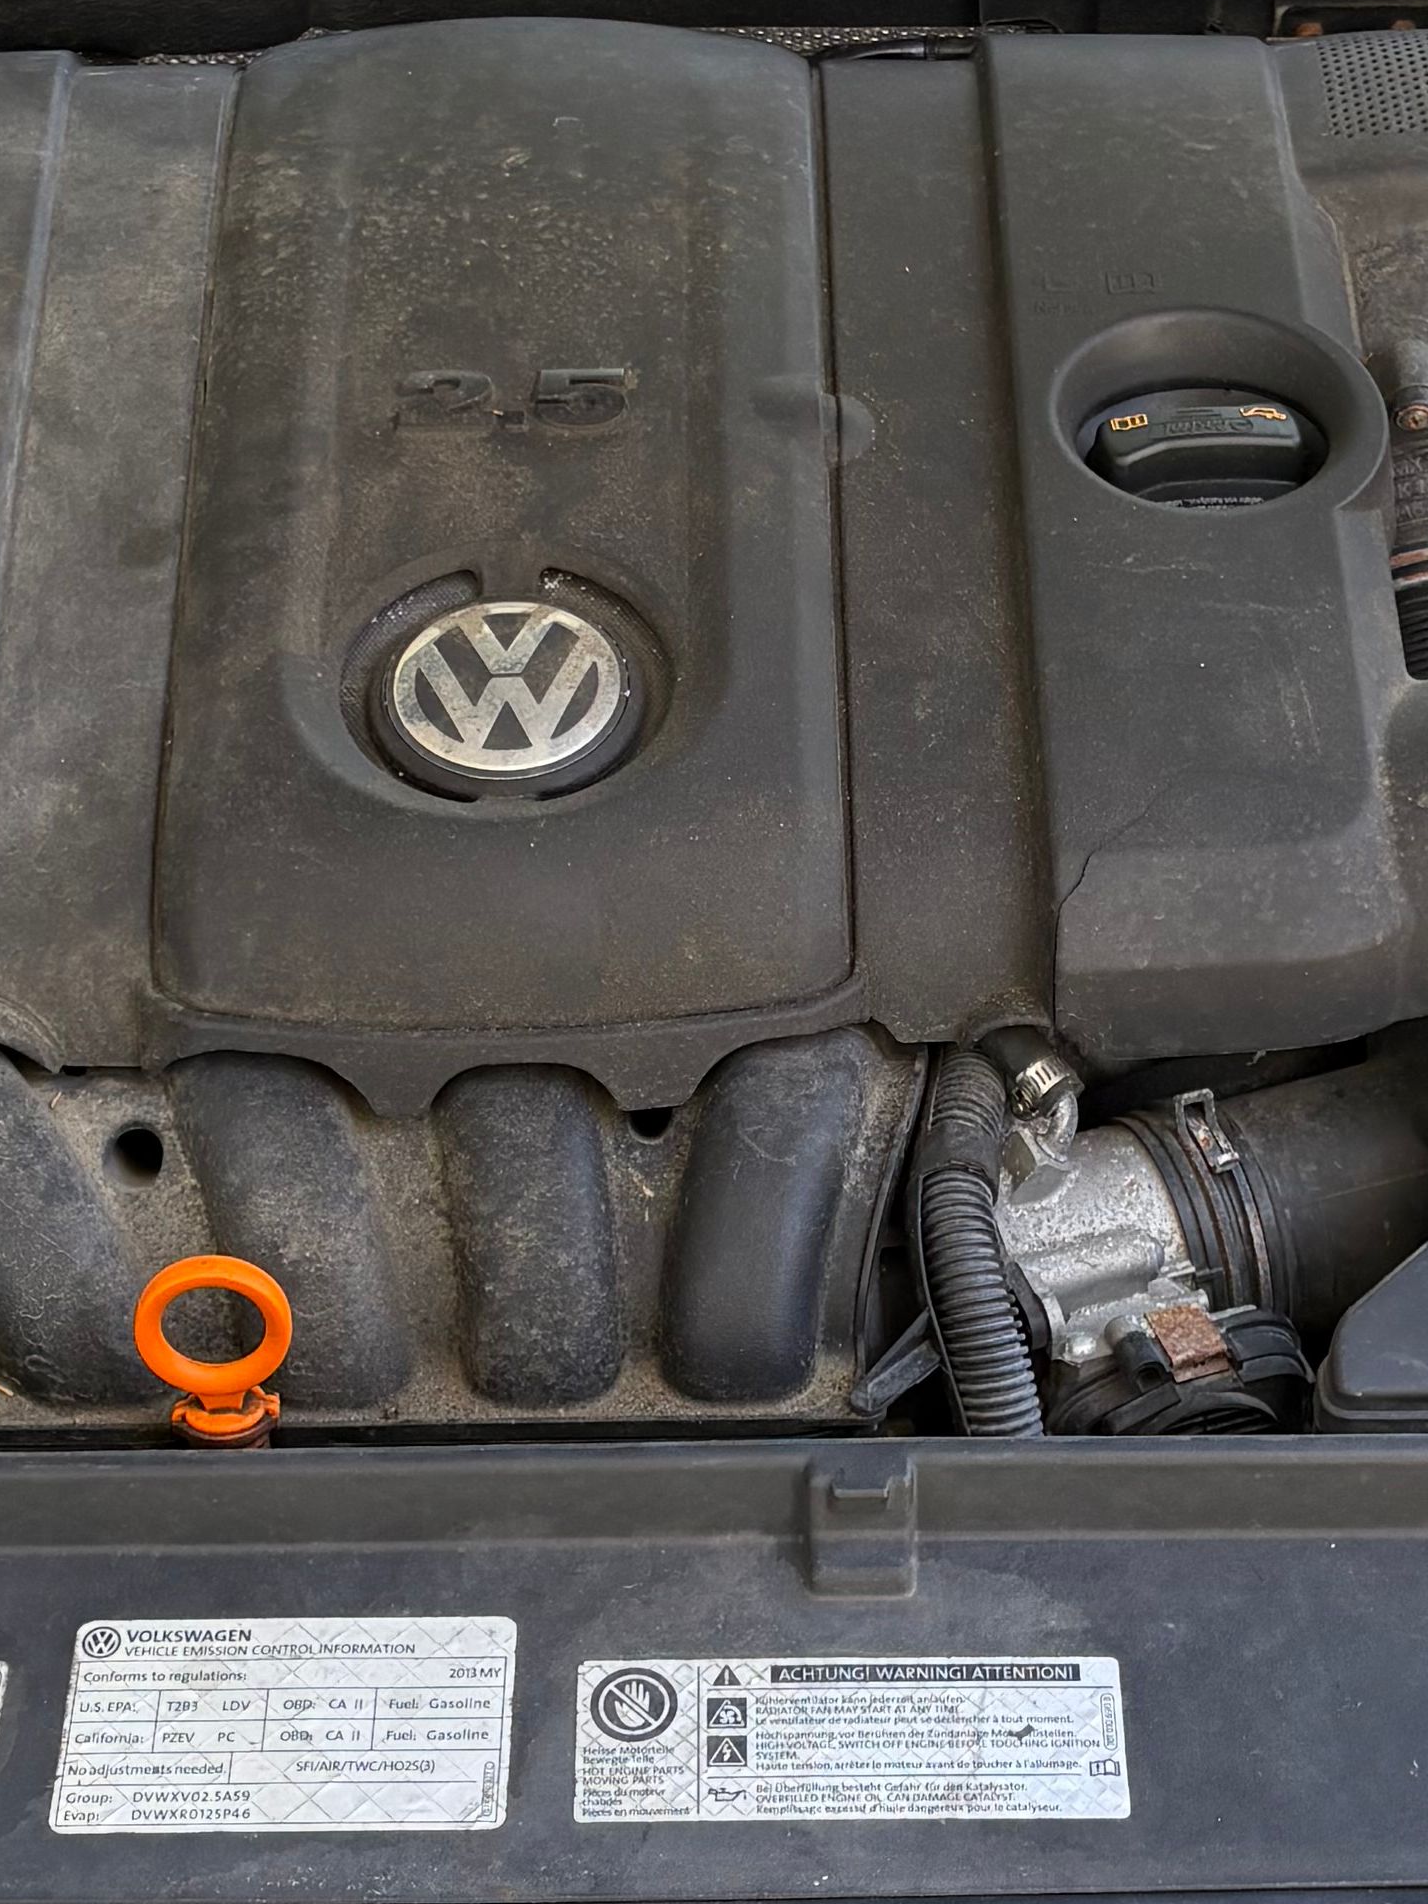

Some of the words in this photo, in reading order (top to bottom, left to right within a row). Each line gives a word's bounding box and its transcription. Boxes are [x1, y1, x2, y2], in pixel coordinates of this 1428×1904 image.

[394, 368, 628, 435] 2.5
[393, 601, 622, 771] VW
[127, 1629, 252, 1643] VOLKSWAGEN
[125, 1645, 178, 1657] VEHICLE
[183, 1645, 247, 1656] EMISSION
[252, 1644, 314, 1656] CONTROL
[319, 1644, 416, 1654] INFORMATION
[84, 1671, 147, 1683] Conforms
[152, 1672, 165, 1682] to
[169, 1671, 246, 1684] regulations:
[449, 1668, 477, 1678] 2013
[480, 1667, 501, 1678] MY
[778, 1666, 870, 1681] ACHTUNG!
[875, 1666, 967, 1680] WARNING!
[972, 1666, 1073, 1680] ATTENTION!
[79, 1701, 104, 1713] U.S.
[107, 1701, 137, 1713] EPA:
[167, 1701, 199, 1711] T2B3
[222, 1700, 251, 1711] LDV
[283, 1699, 316, 1710] OBD:
[328, 1698, 347, 1709] CA
[388, 1698, 419, 1709] Fuel:
[429, 1698, 491, 1709] Gasoline
[755, 1706, 808, 1715] RADIATOR
[810, 1706, 832, 1714] FAN
[834, 1705, 859, 1714] MAY
[860, 1706, 891, 1714] START
[910, 1705, 931, 1713] ANY
[769, 1716, 825, 1725] ventilateur
[828, 1716, 840, 1724] de
[843, 1714, 891, 1724] radiateur
[894, 1715, 918, 1725] peut
[1001, 1715, 1023, 1723] tout
[1027, 1715, 1074, 1723] moment.
[75, 1732, 144, 1744] California:
[162, 1732, 194, 1743] PZEV
[218, 1731, 236, 1742] PC
[280, 1730, 313, 1741] OBD:
[326, 1730, 344, 1741] CA
[385, 1730, 417, 1741] Fuel:
[426, 1729, 489, 1741] Gasoline
[839, 1740, 880, 1749] SWITCH
[882, 1740, 902, 1748] OFF
[990, 1740, 1048, 1748] TOUCHING
[1051, 1740, 1100, 1748] IGNITION
[755, 1751, 801, 1760] SYSTEM.
[68, 1765, 87, 1776] No
[89, 1764, 172, 1778] adjustments
[174, 1763, 227, 1775] needed.
[296, 1760, 435, 1773] SFI/AIR/TWC/HO2S(3)
[652, 1766, 684, 1775] PARTS
[755, 1762, 787, 1771] Haute
[884, 1761, 922, 1769] moteur
[925, 1761, 954, 1769] avant
[957, 1760, 970, 1769] de
[973, 1759, 1013, 1769] toucher
[583, 1776, 629, 1785] MOVING
[632, 1775, 664, 1784] PARTS
[614, 1788, 627, 1797] du
[842, 1782, 881, 1792] besteht
[884, 1782, 921, 1792] Gefahr
[943, 1783, 962, 1791] den
[966, 1782, 1028, 1794] Katalysator.
[66, 1793, 113, 1805] Group:
[755, 1794, 818, 1803] OVERFILLED
[821, 1793, 861, 1802] ENGINE
[887, 1793, 909, 1801] CAN
[967, 1804, 991, 1813] pour
[1006, 1803, 1062, 1813] catalyseur.
[63, 1811, 99, 1823] Evap:
